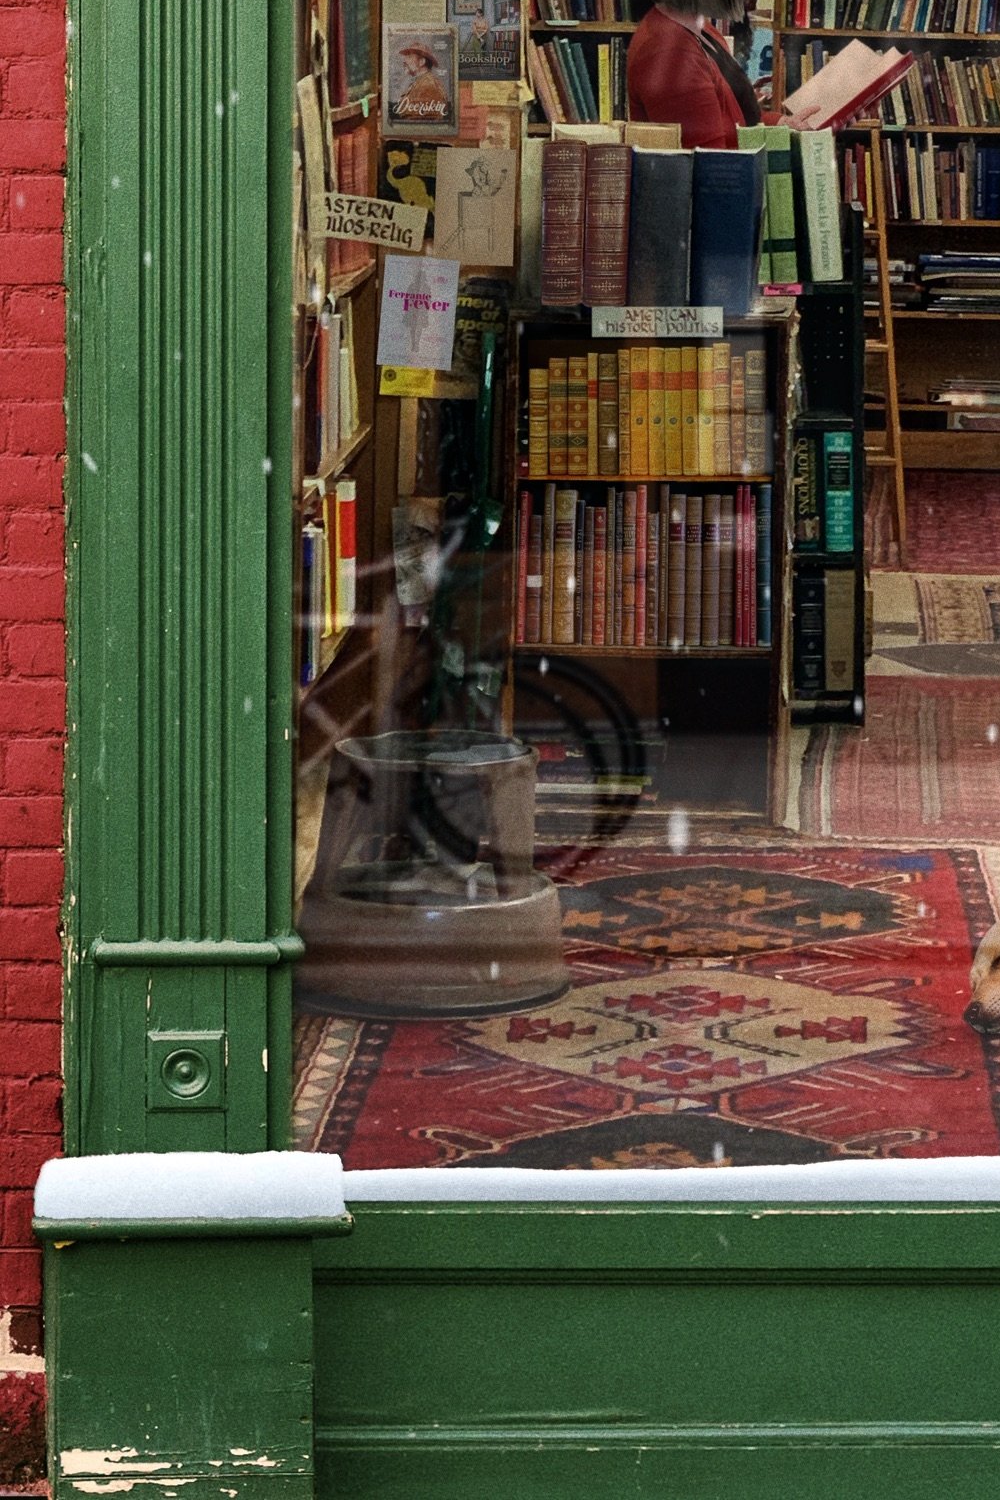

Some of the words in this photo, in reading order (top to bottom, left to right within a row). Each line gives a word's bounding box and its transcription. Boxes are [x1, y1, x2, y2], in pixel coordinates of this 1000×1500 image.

[458, 53, 511, 65] Bookshop
[392, 97, 448, 116] Deerskin
[325, 196, 395, 220] ASTERN
[388, 289, 432, 300] Ferrante
[402, 299, 450, 312] Fever
[624, 308, 698, 322] AMERICAN
[666, 321, 719, 335] POLITICS
